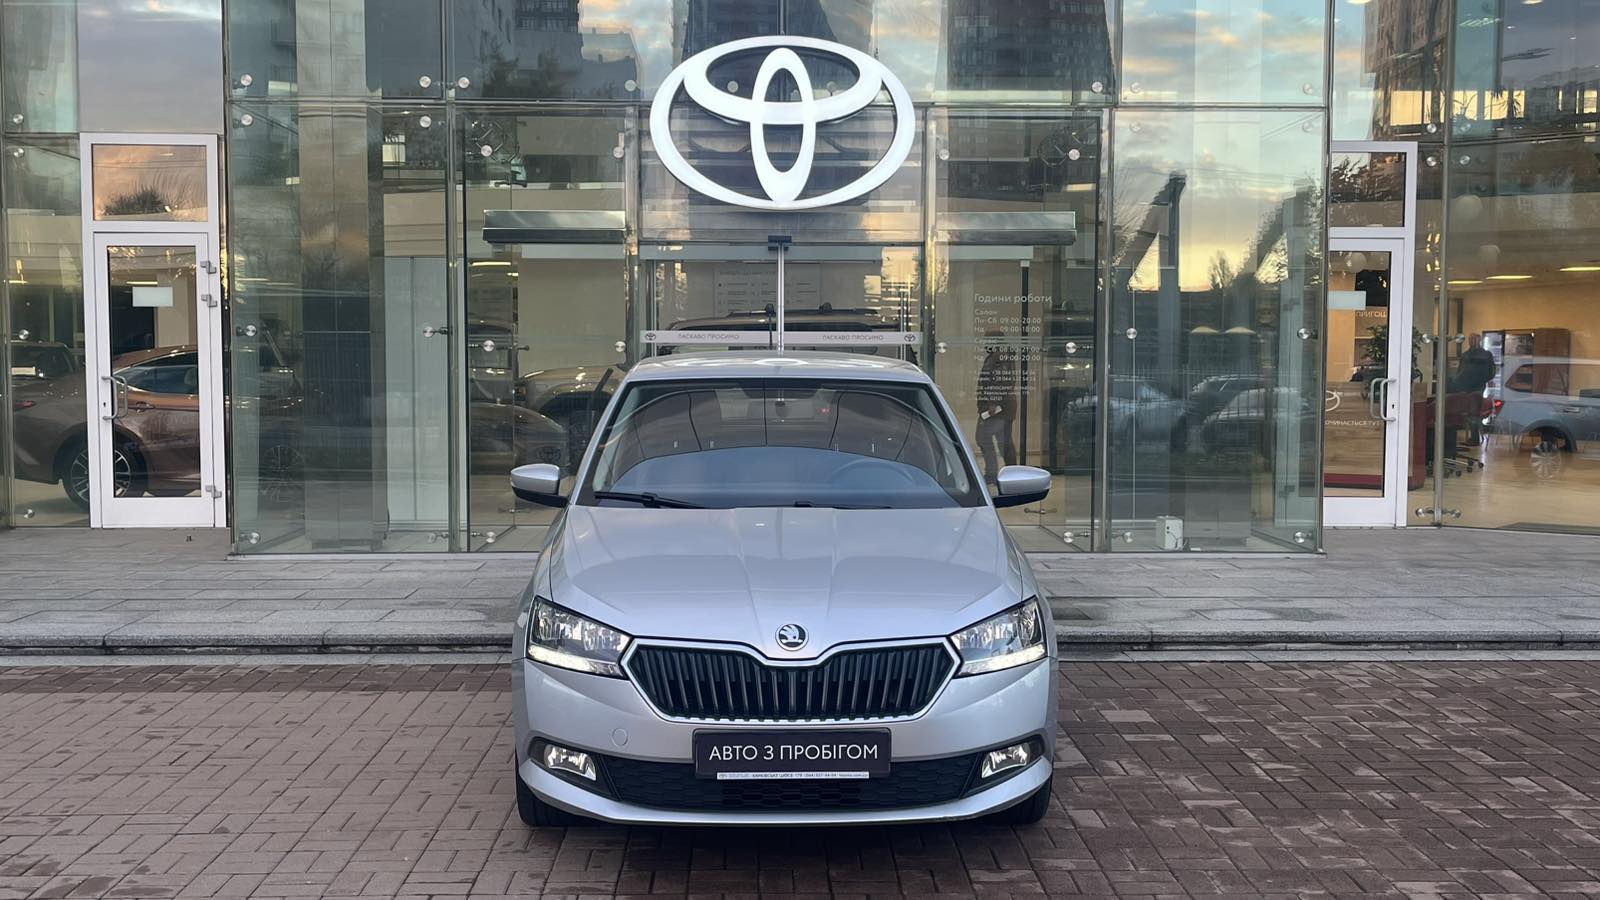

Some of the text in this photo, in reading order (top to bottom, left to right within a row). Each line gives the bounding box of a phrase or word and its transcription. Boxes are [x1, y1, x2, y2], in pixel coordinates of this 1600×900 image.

[974, 293, 1053, 304] Години роботи
[709, 744, 878, 761] АВТО З ПРОБІГОМ
